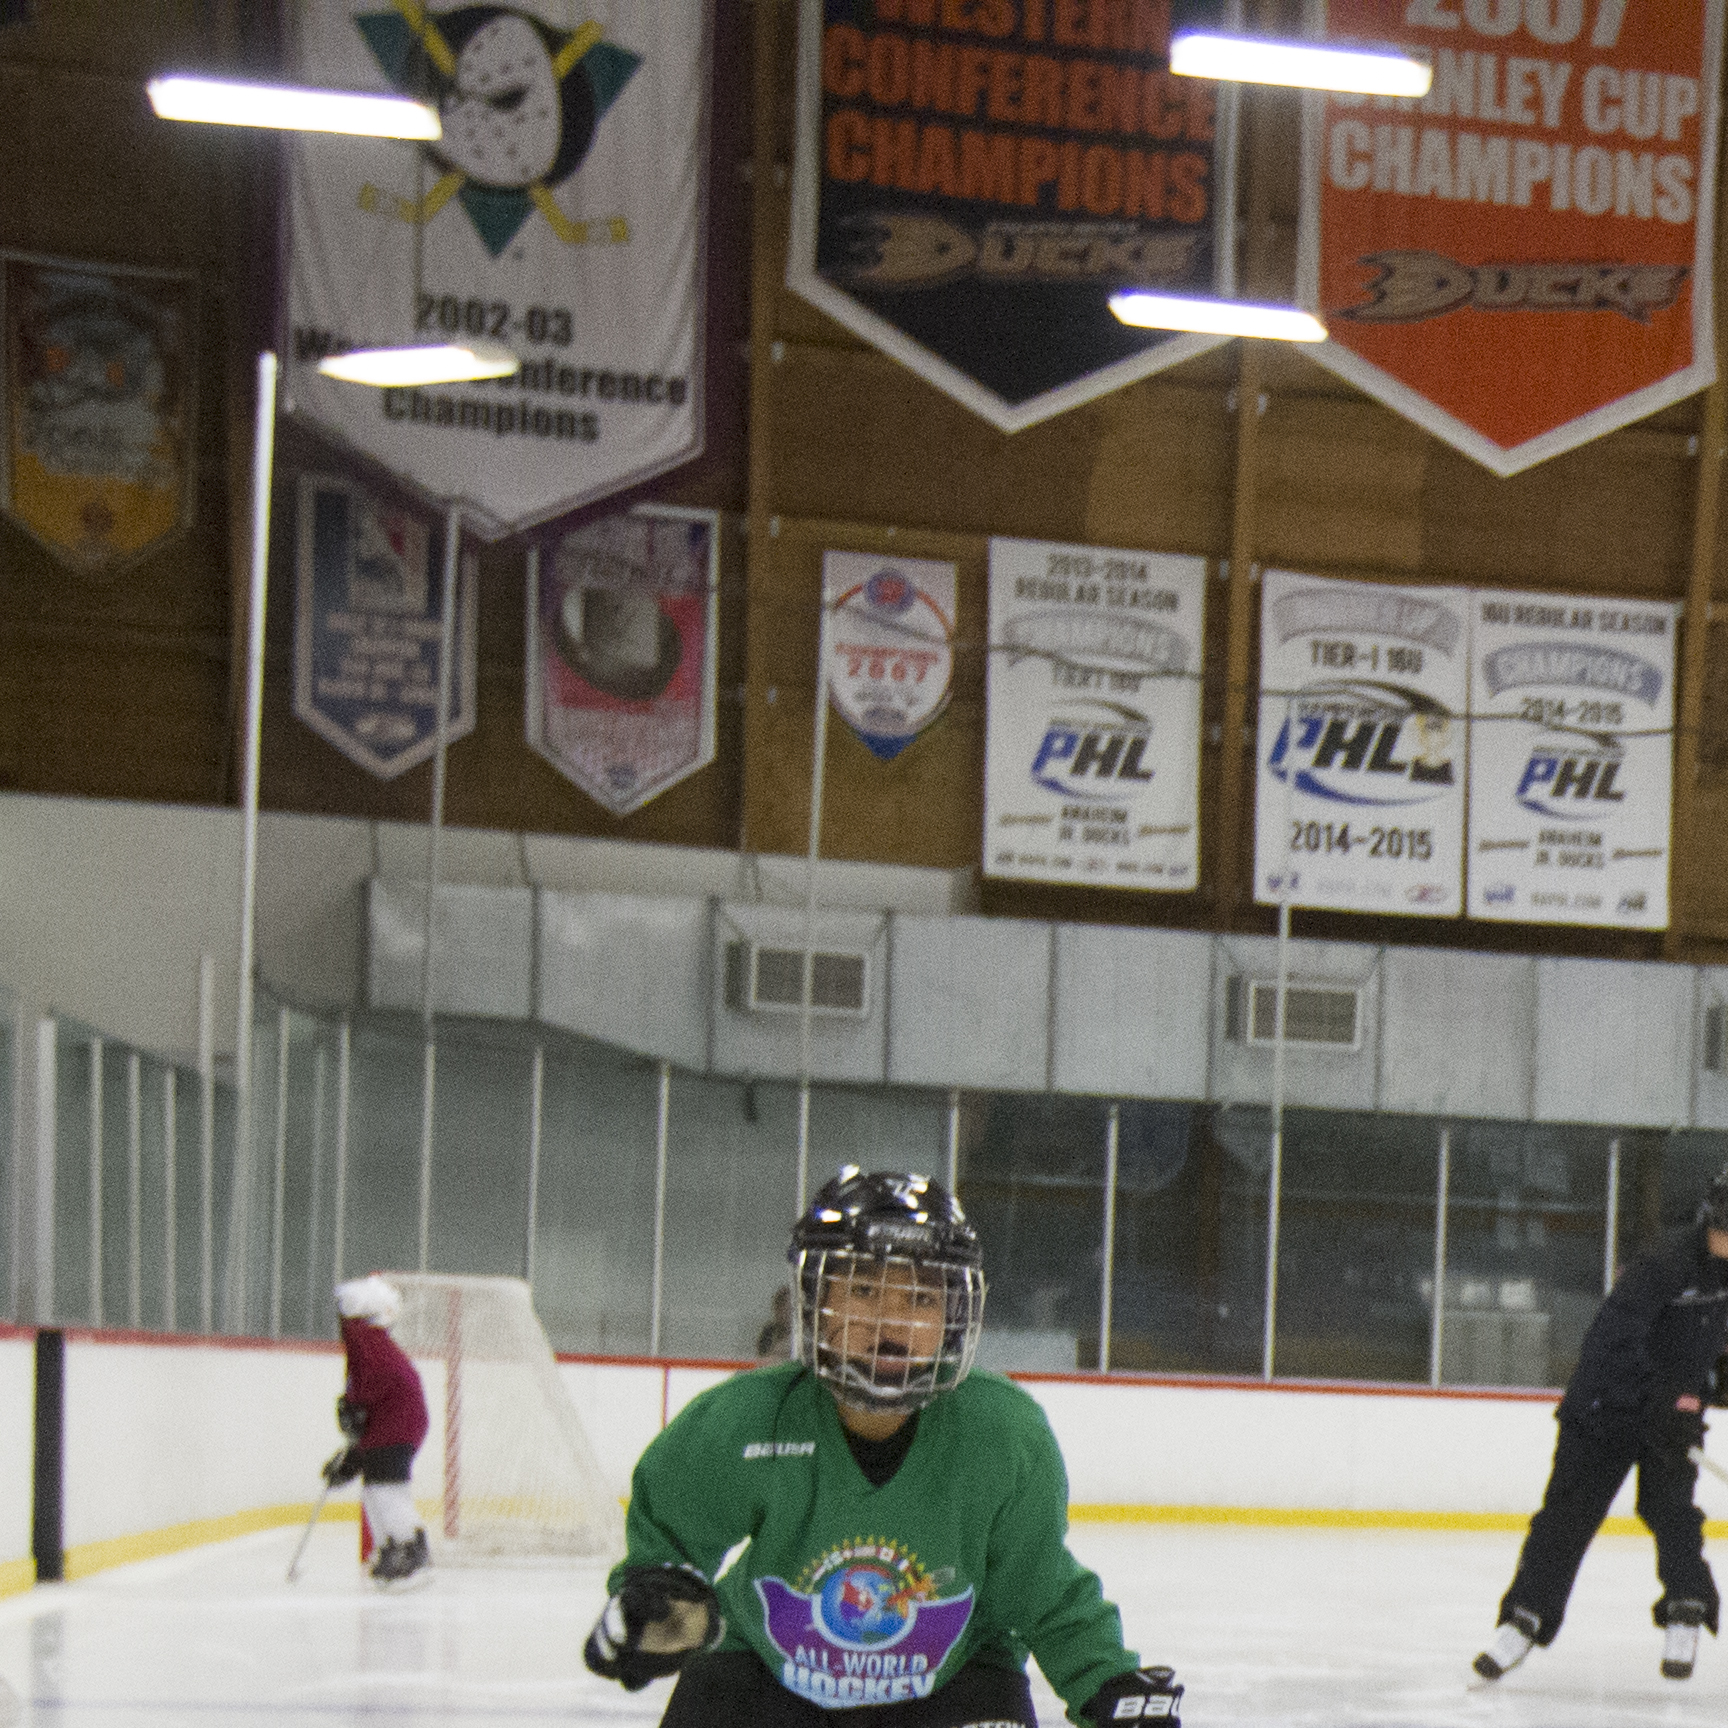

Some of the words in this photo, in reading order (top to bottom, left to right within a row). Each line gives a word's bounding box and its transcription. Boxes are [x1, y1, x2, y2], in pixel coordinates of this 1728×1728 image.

[823, 23, 1216, 141] CONFERENCE
[1581, 65, 1699, 141] CUP
[826, 109, 1209, 223] CHAMPIONS
[1328, 118, 1695, 224] CHAMPIONS
[412, 290, 576, 348] 2002-03
[470, 352, 688, 406] nference
[381, 385, 601, 444] Champions
[1031, 728, 1155, 783] PHL
[1269, 714, 1409, 774] PHL
[1516, 756, 1627, 802] PHL
[1291, 820, 1435, 862] 2014-2015
